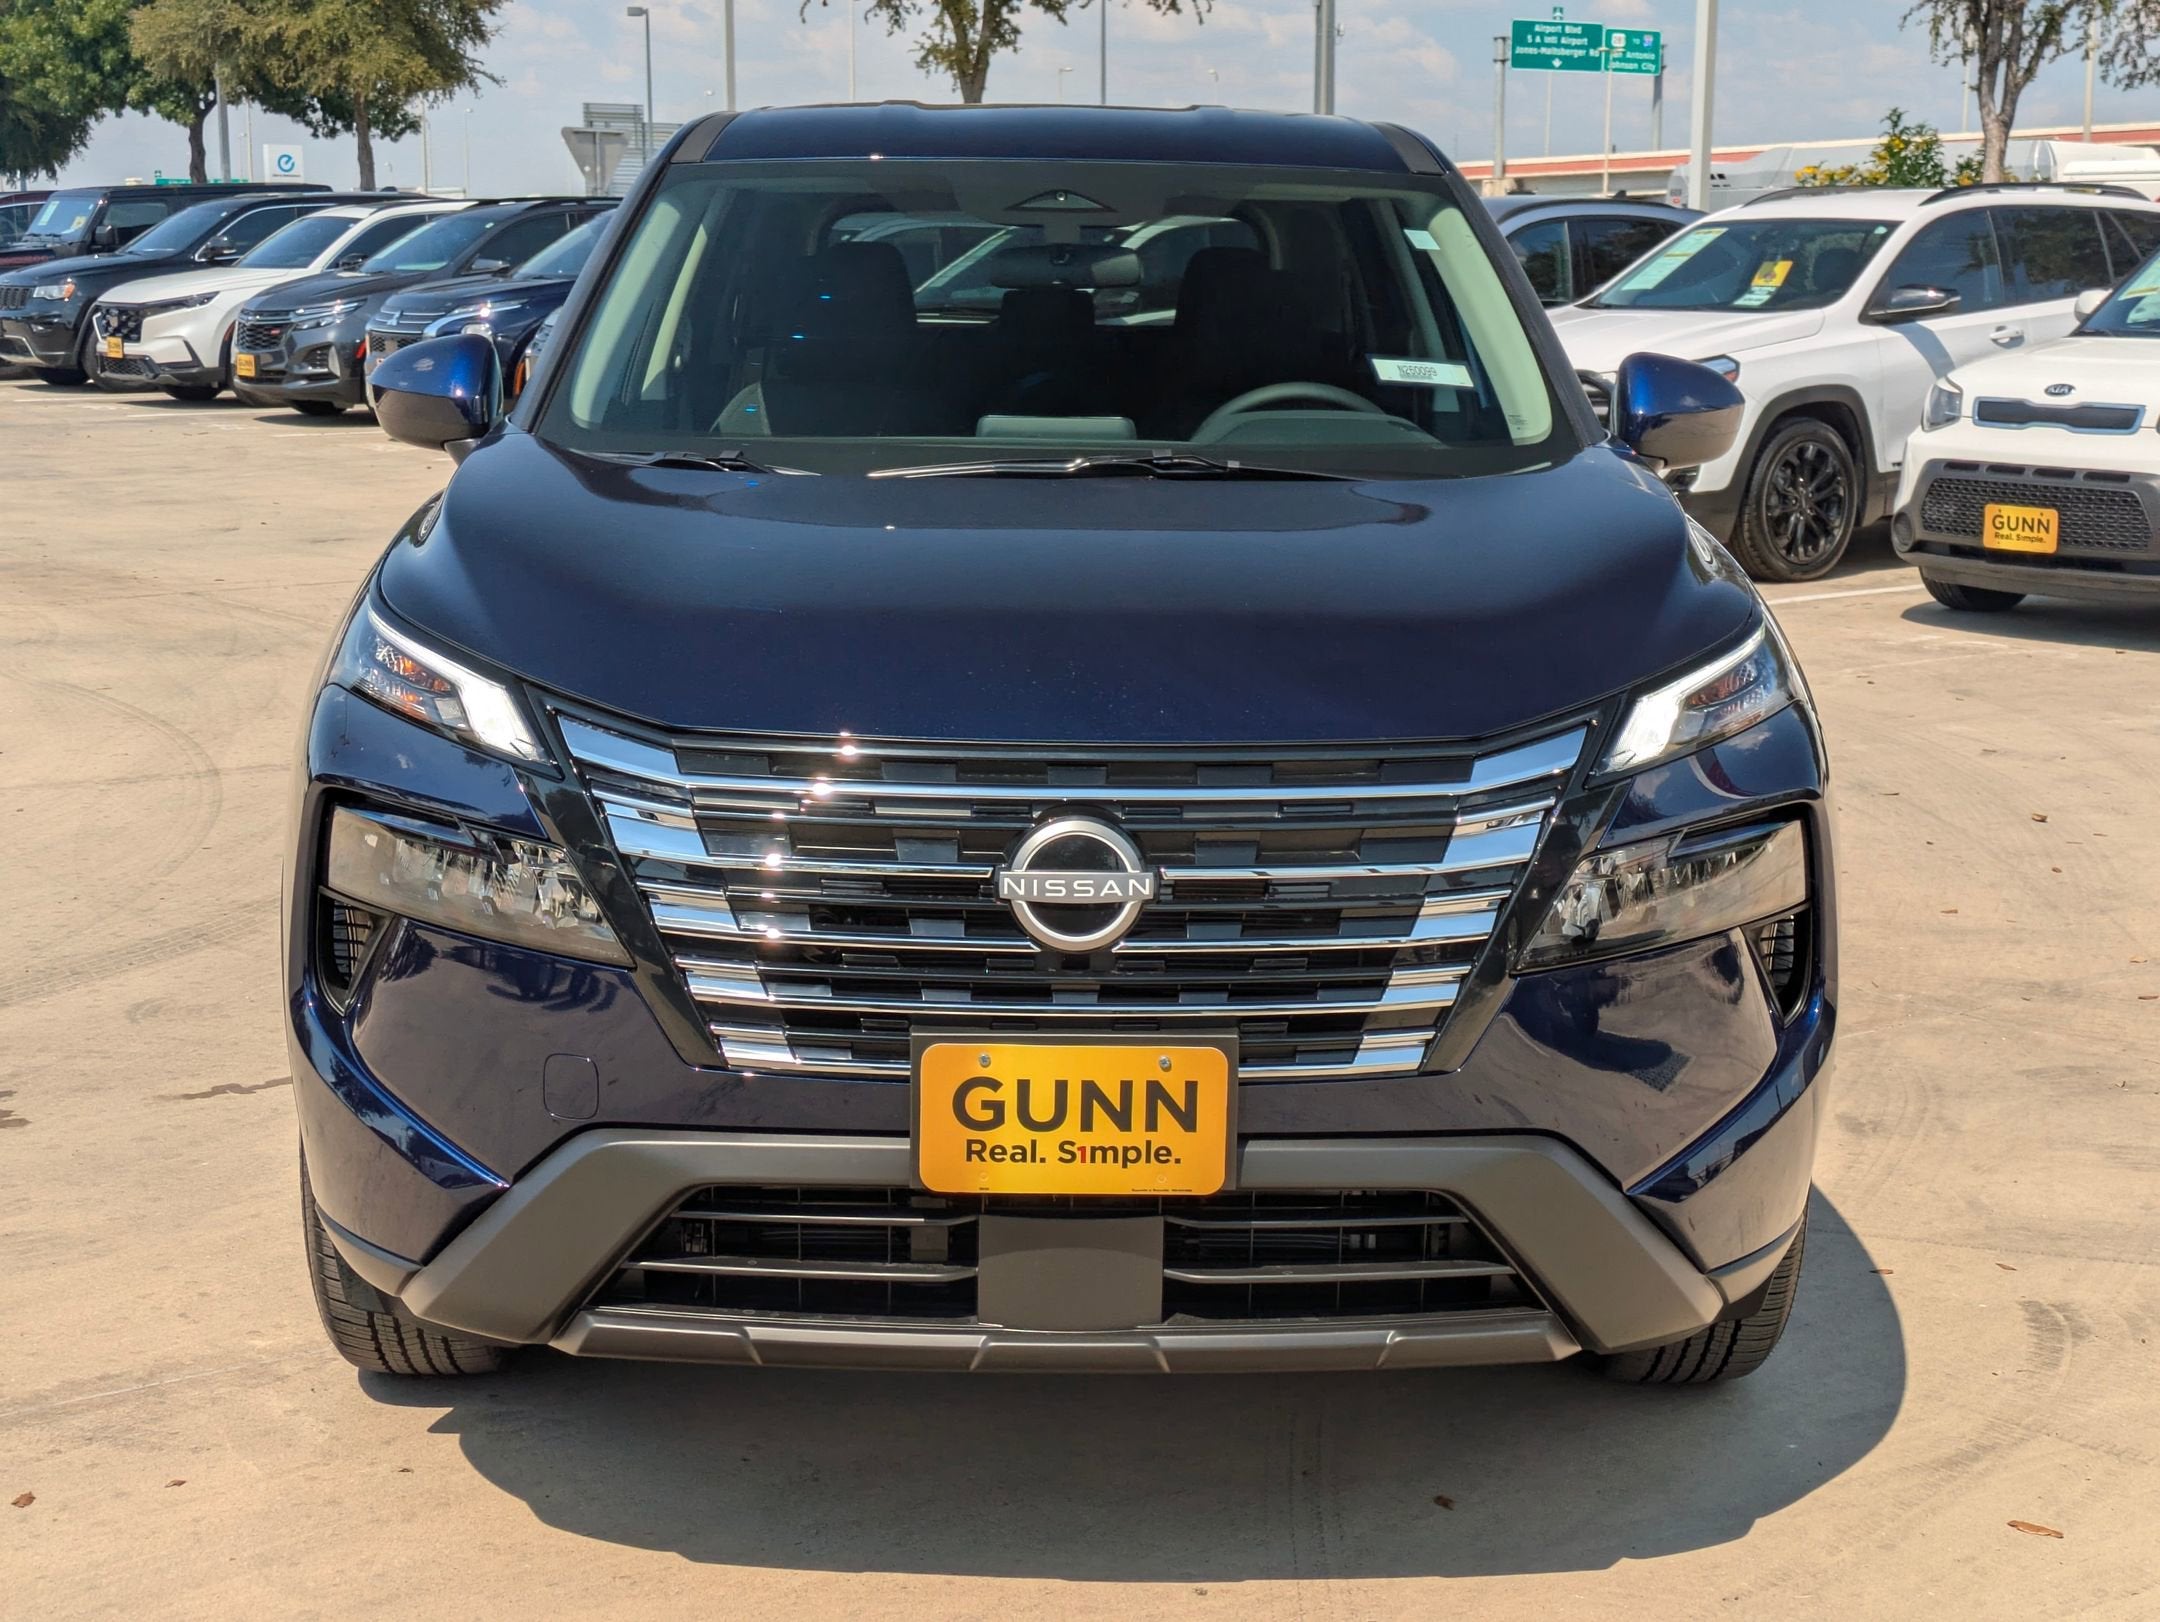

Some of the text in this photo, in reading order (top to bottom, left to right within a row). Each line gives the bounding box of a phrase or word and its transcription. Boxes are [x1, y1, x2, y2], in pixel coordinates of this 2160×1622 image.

[1535, 24, 1561, 33] Airport
[1561, 37, 1588, 46] Airport
[1626, 51, 1655, 60] Antonio
[1641, 62, 1656, 72] City
[1992, 514, 2050, 534] GUNN
[1003, 877, 1150, 897] NISSAN
[952, 1076, 1198, 1133] GUNN
[966, 1139, 1046, 1164] Real.
